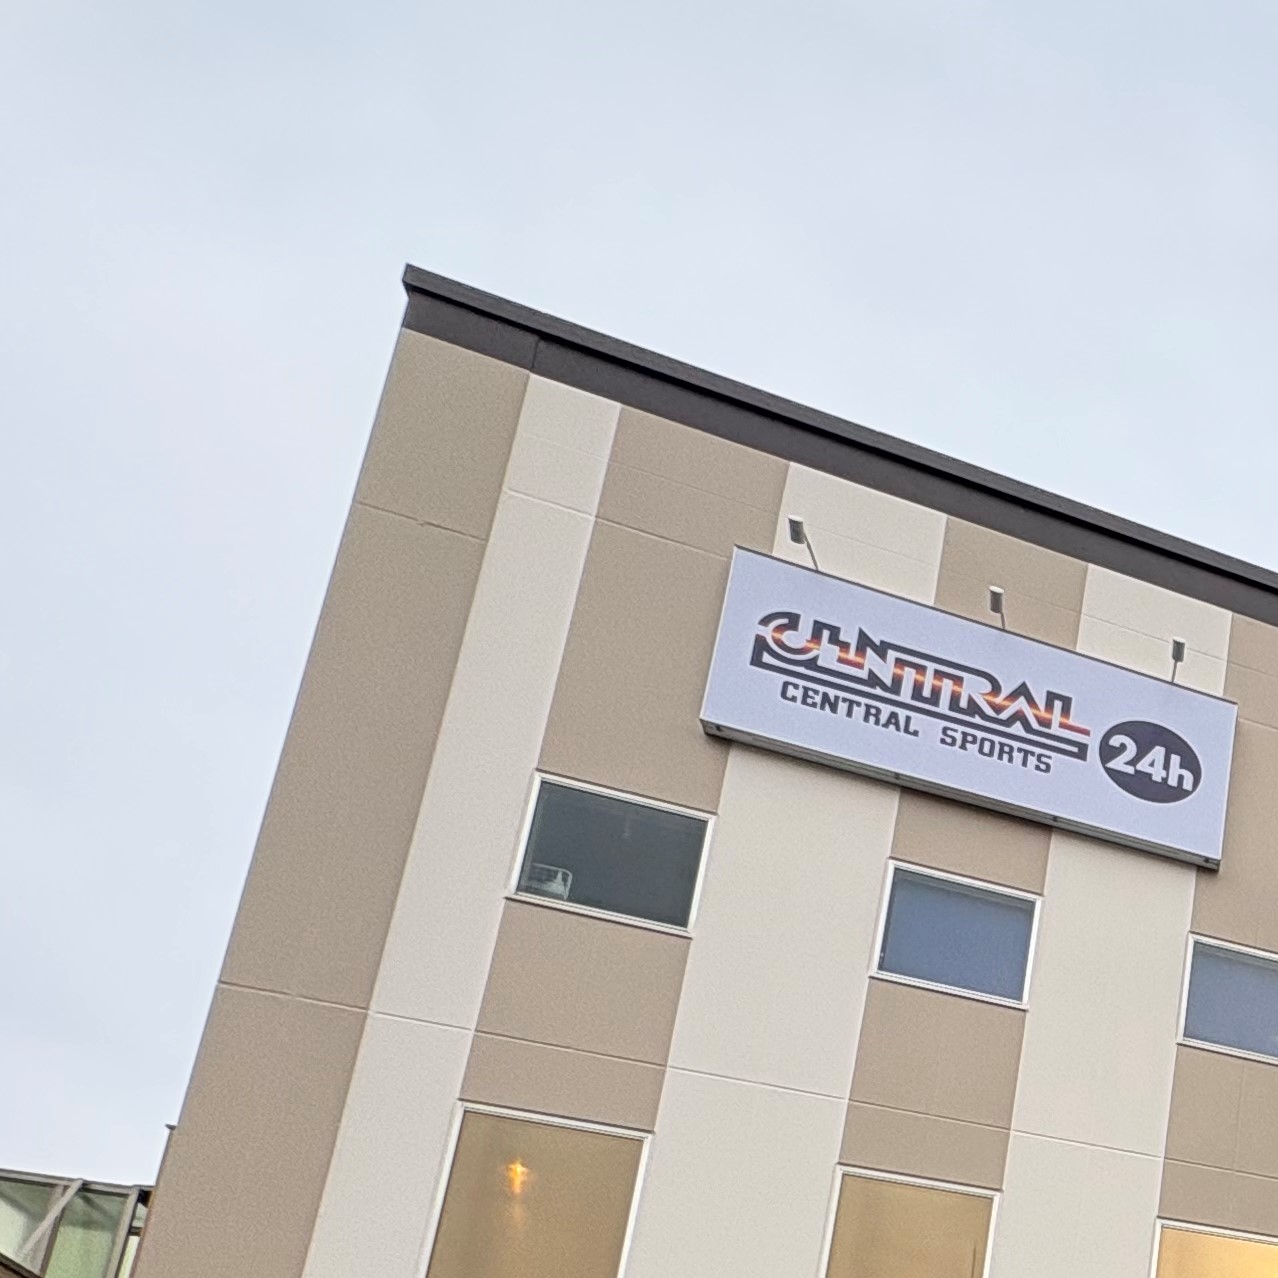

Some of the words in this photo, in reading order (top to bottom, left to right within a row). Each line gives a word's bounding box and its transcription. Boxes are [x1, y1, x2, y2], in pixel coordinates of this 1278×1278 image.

[780, 678, 920, 738] CENTRAL
[939, 726, 1054, 775] SPORTS
[1104, 732, 1195, 793] 24h
